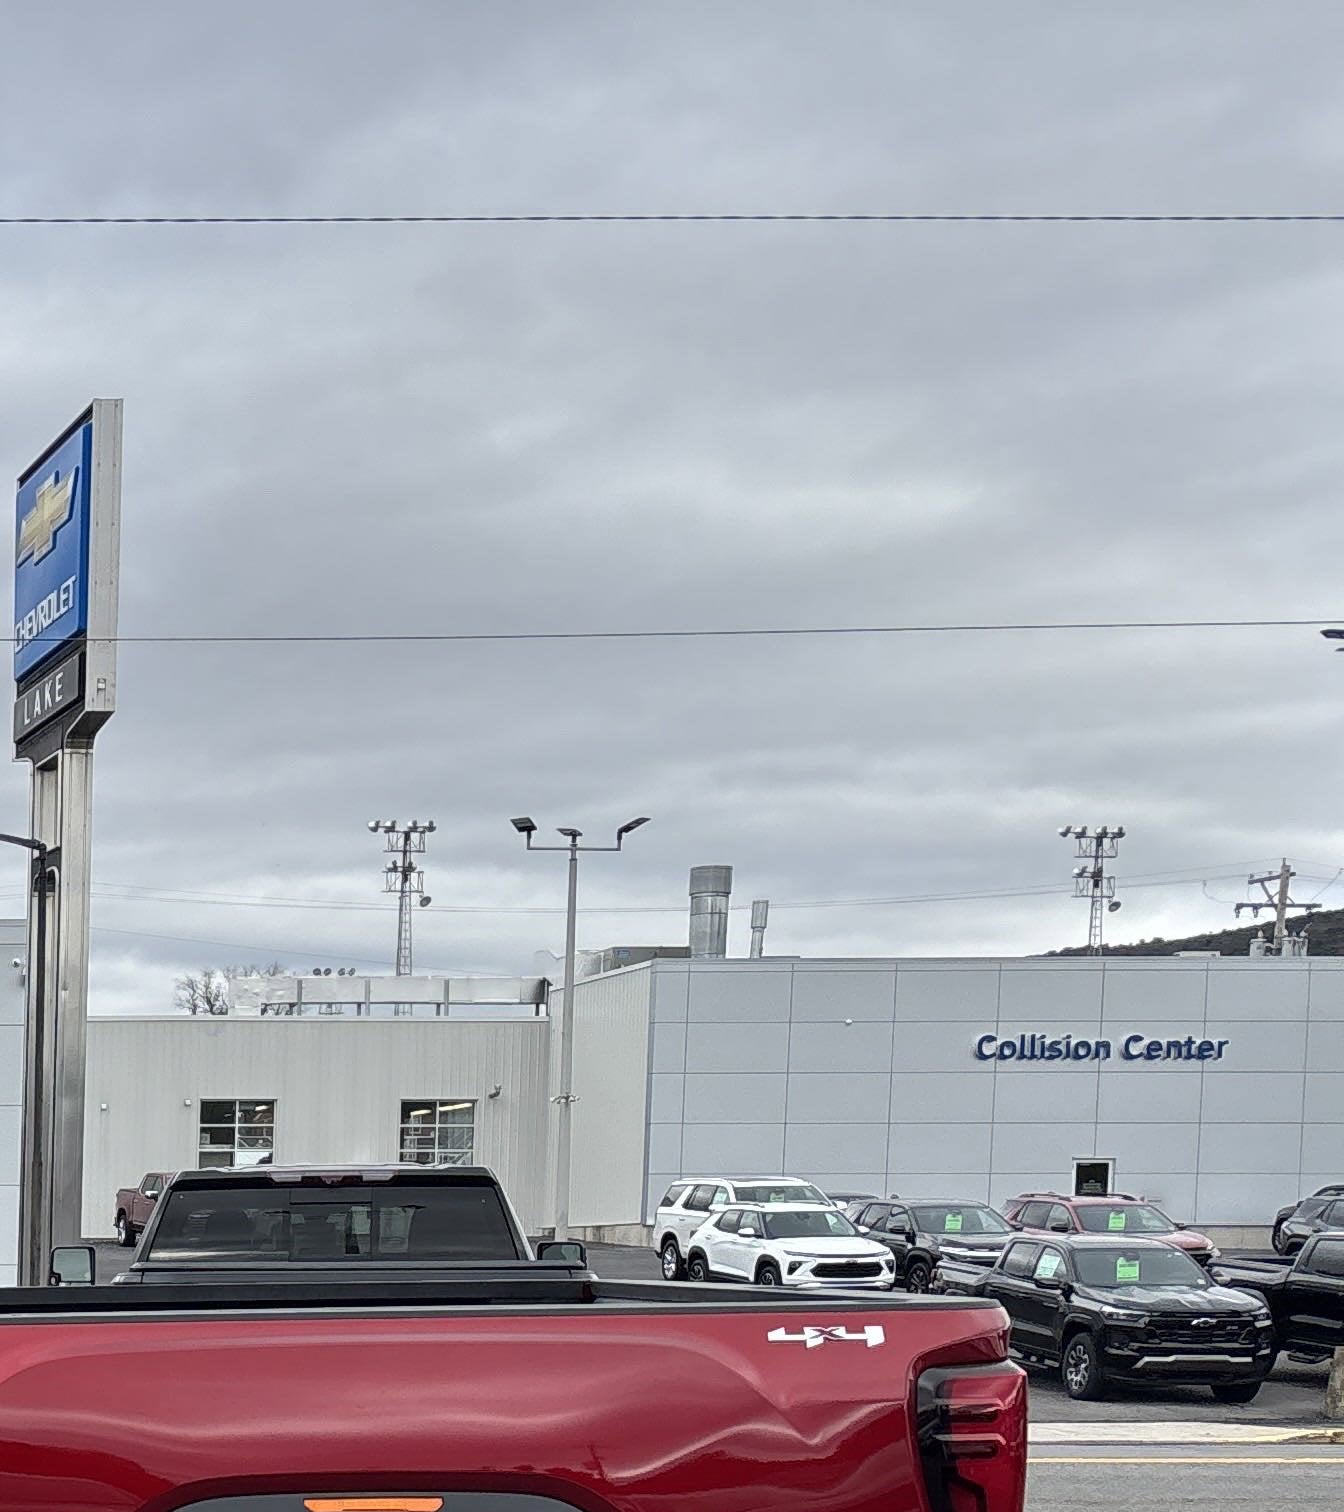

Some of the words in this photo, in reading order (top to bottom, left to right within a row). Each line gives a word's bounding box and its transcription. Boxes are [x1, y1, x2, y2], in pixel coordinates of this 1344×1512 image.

[14, 575, 77, 653] CHEVROLET
[22, 671, 65, 726] LAKE
[975, 1034, 1112, 1061] Collision
[1121, 1034, 1230, 1061] Center
